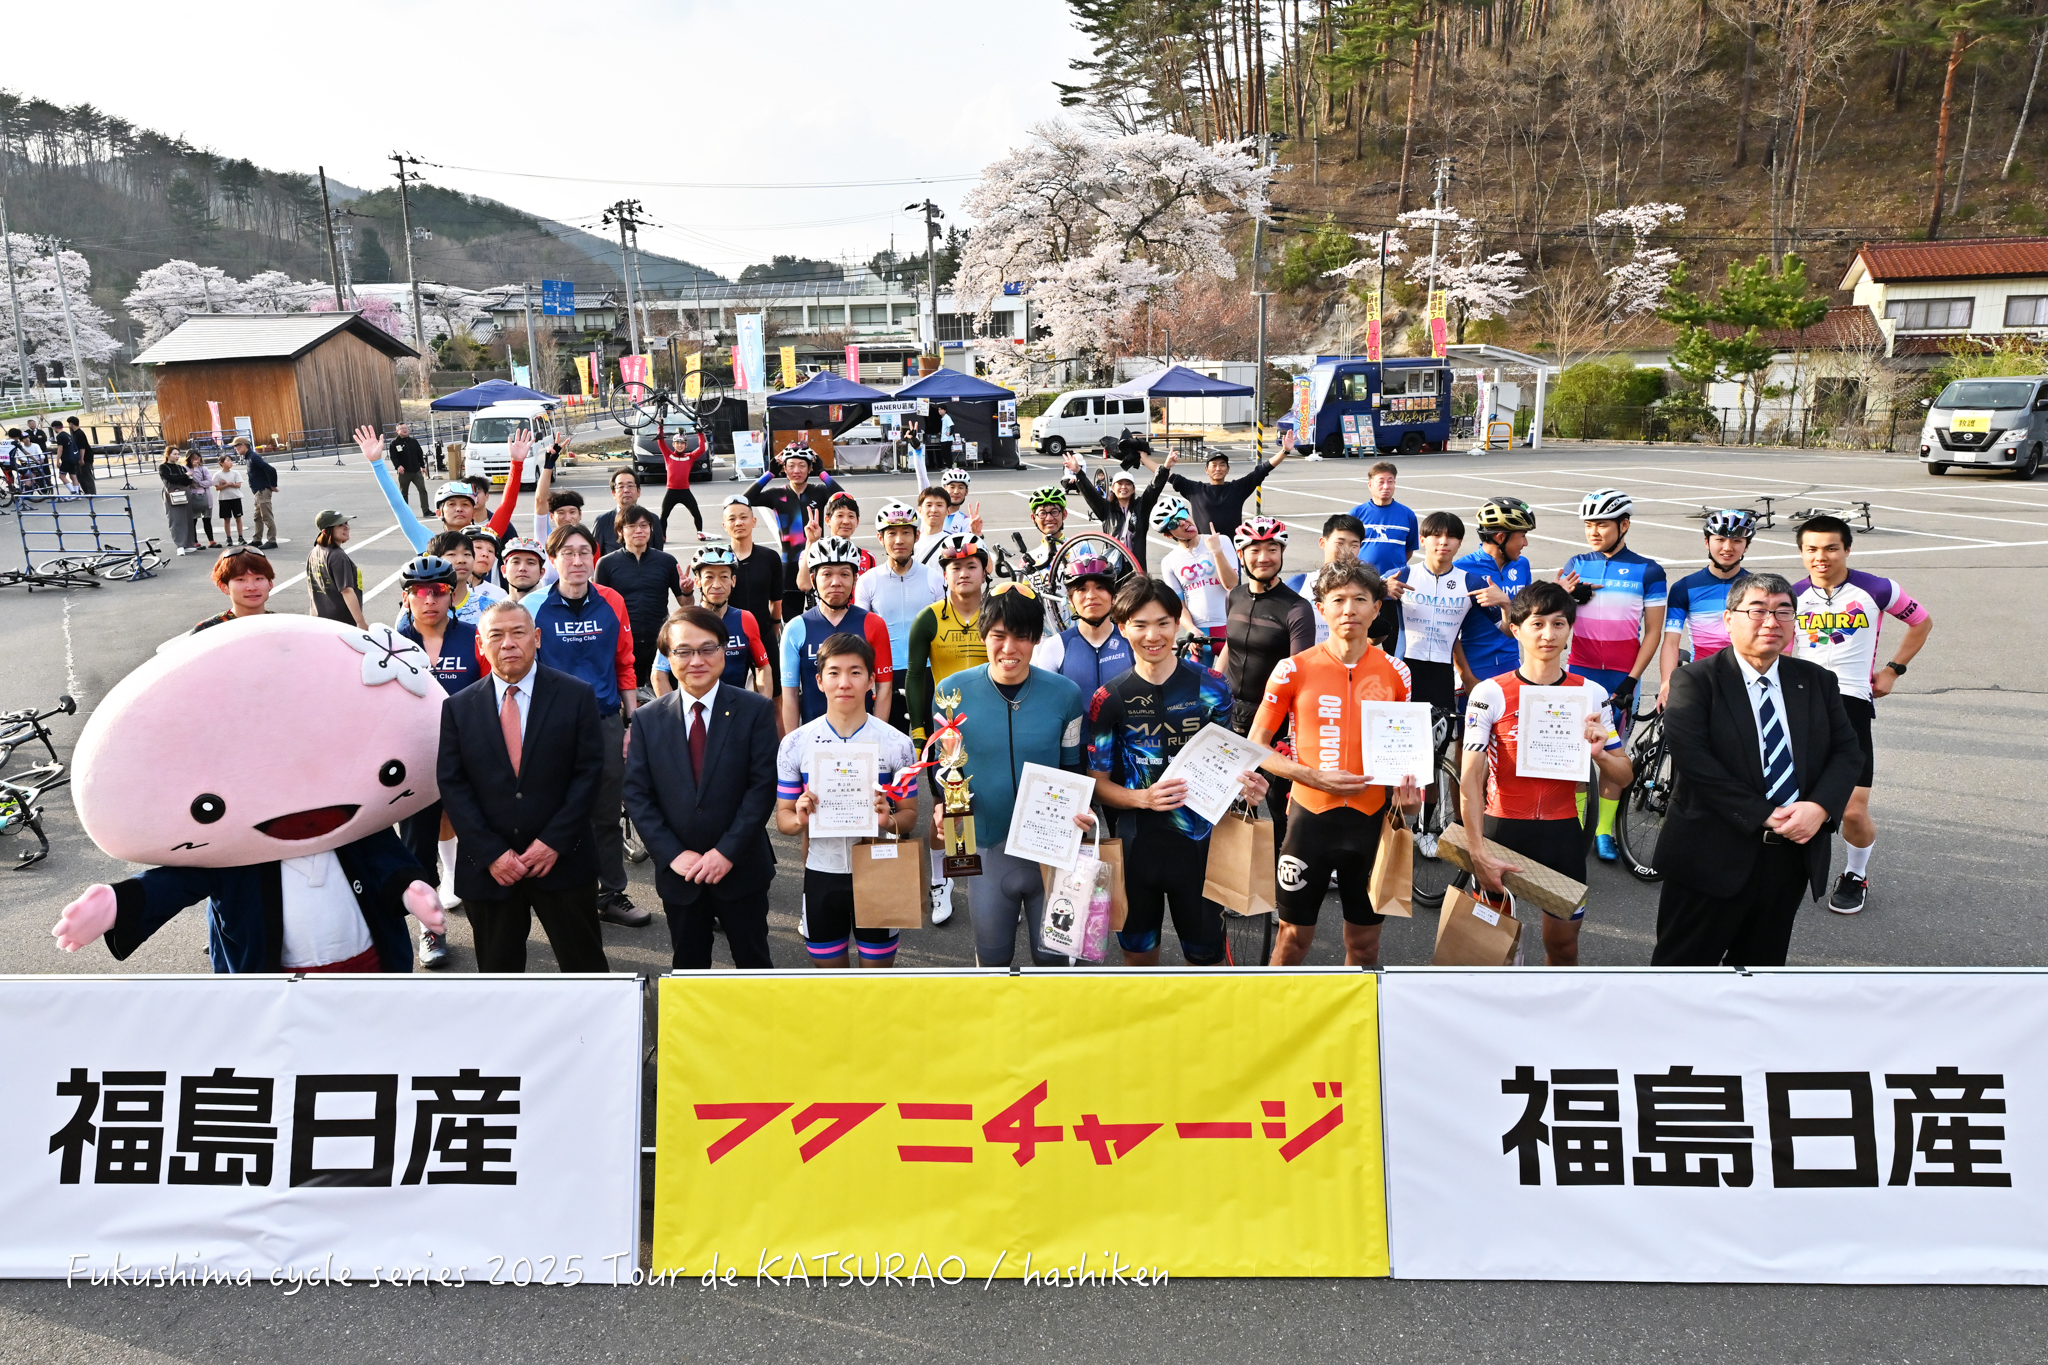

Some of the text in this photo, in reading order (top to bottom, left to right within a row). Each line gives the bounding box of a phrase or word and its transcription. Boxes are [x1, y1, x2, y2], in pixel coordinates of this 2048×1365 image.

[1605, 580, 1639, 590] 学法石川
[1405, 590, 1466, 609] KOMAMI
[1435, 608, 1464, 616] RACING
[1796, 612, 1869, 630] TAIRA
[554, 620, 603, 635] LEZEL
[583, 634, 597, 642] Club
[1318, 694, 1343, 772] ROAD-RO
[48, 1067, 521, 1188] 福島日産
[693, 1079, 1344, 1168] フクニチャージ
[1501, 1065, 2012, 1189] 福島日産
